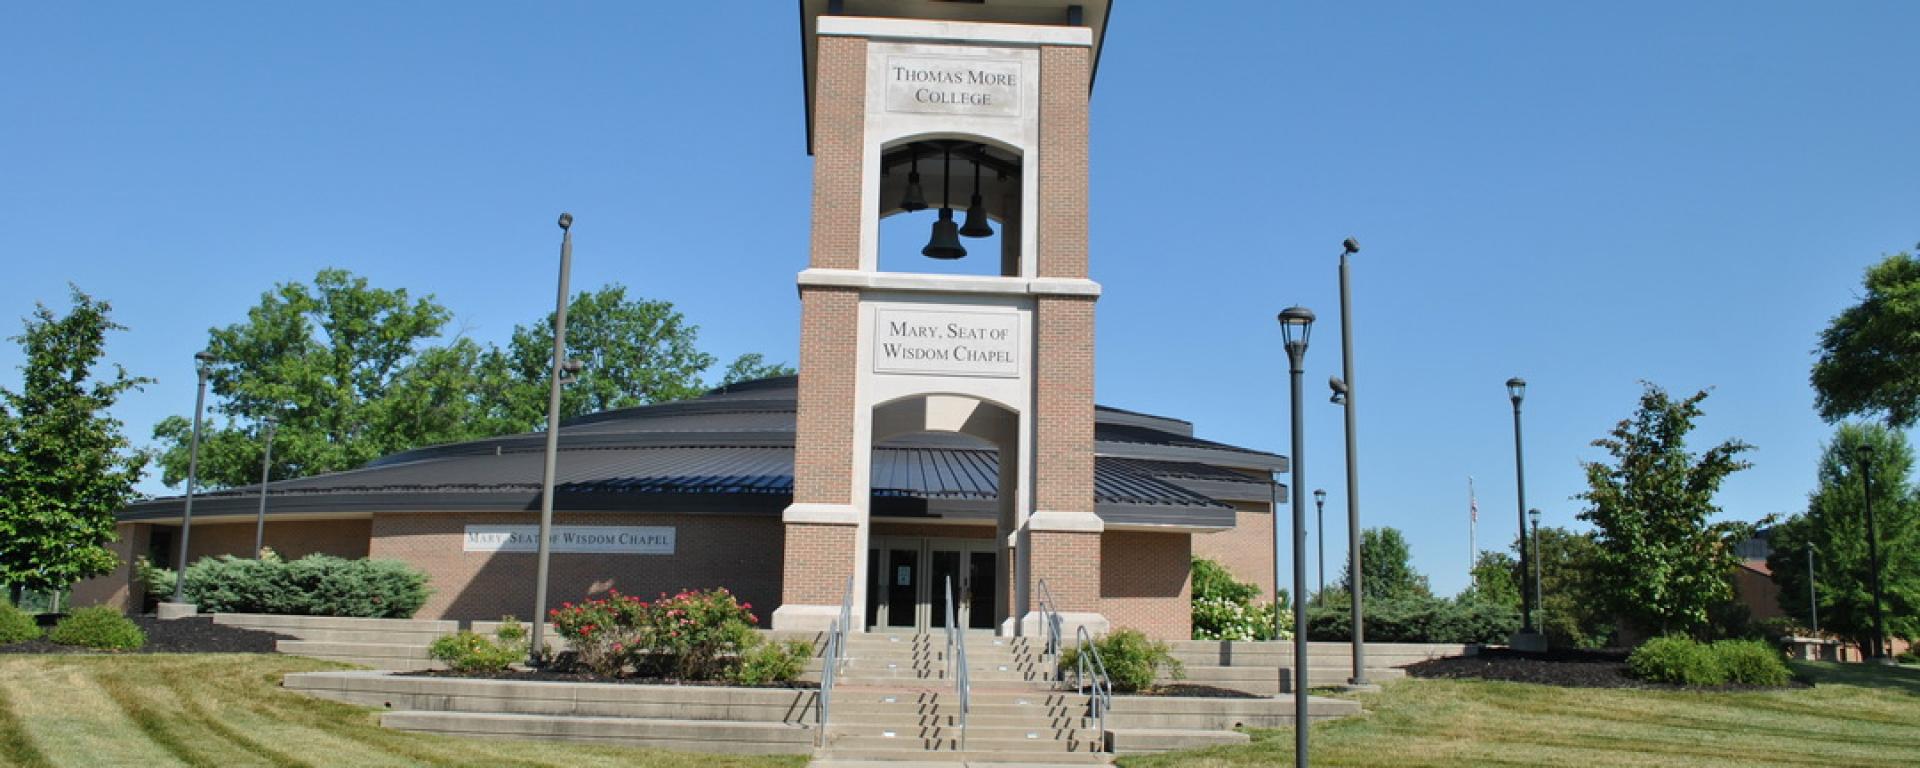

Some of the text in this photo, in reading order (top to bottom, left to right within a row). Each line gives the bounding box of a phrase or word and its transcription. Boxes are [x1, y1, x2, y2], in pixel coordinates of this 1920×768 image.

[893, 66, 1017, 86] THOMAS MORE
[915, 88, 992, 105] COLLEGE
[946, 322, 987, 339] SEAT
[989, 328, 1009, 340] OF
[883, 342, 1014, 363] WISDOM CHAPEL
[563, 532, 615, 545] WISDOM
[618, 533, 670, 546] CHAPEL
